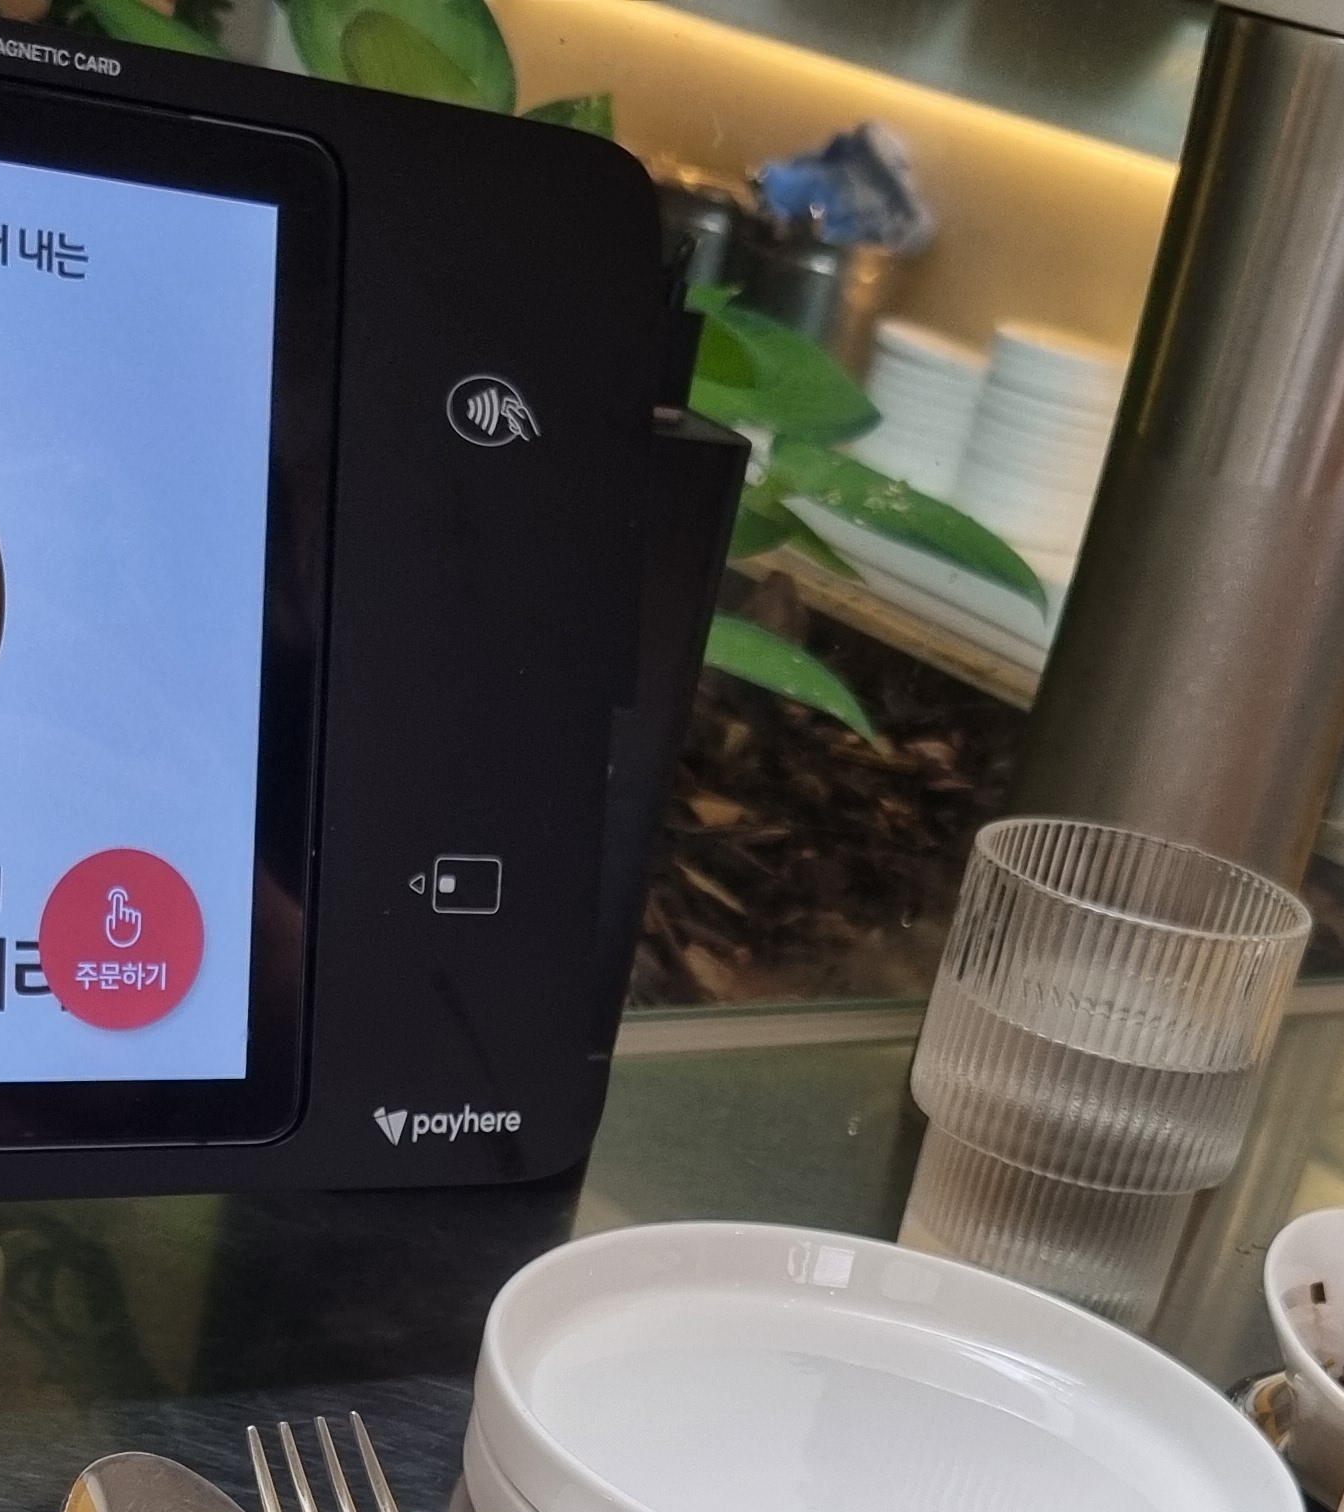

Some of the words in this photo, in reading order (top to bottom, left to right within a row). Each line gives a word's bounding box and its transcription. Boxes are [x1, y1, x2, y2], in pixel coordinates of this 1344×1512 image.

[74, 53, 121, 76] CARD
[19, 227, 90, 280] 내는
[75, 962, 167, 991] 주문하기
[412, 1103, 522, 1142] payhere
